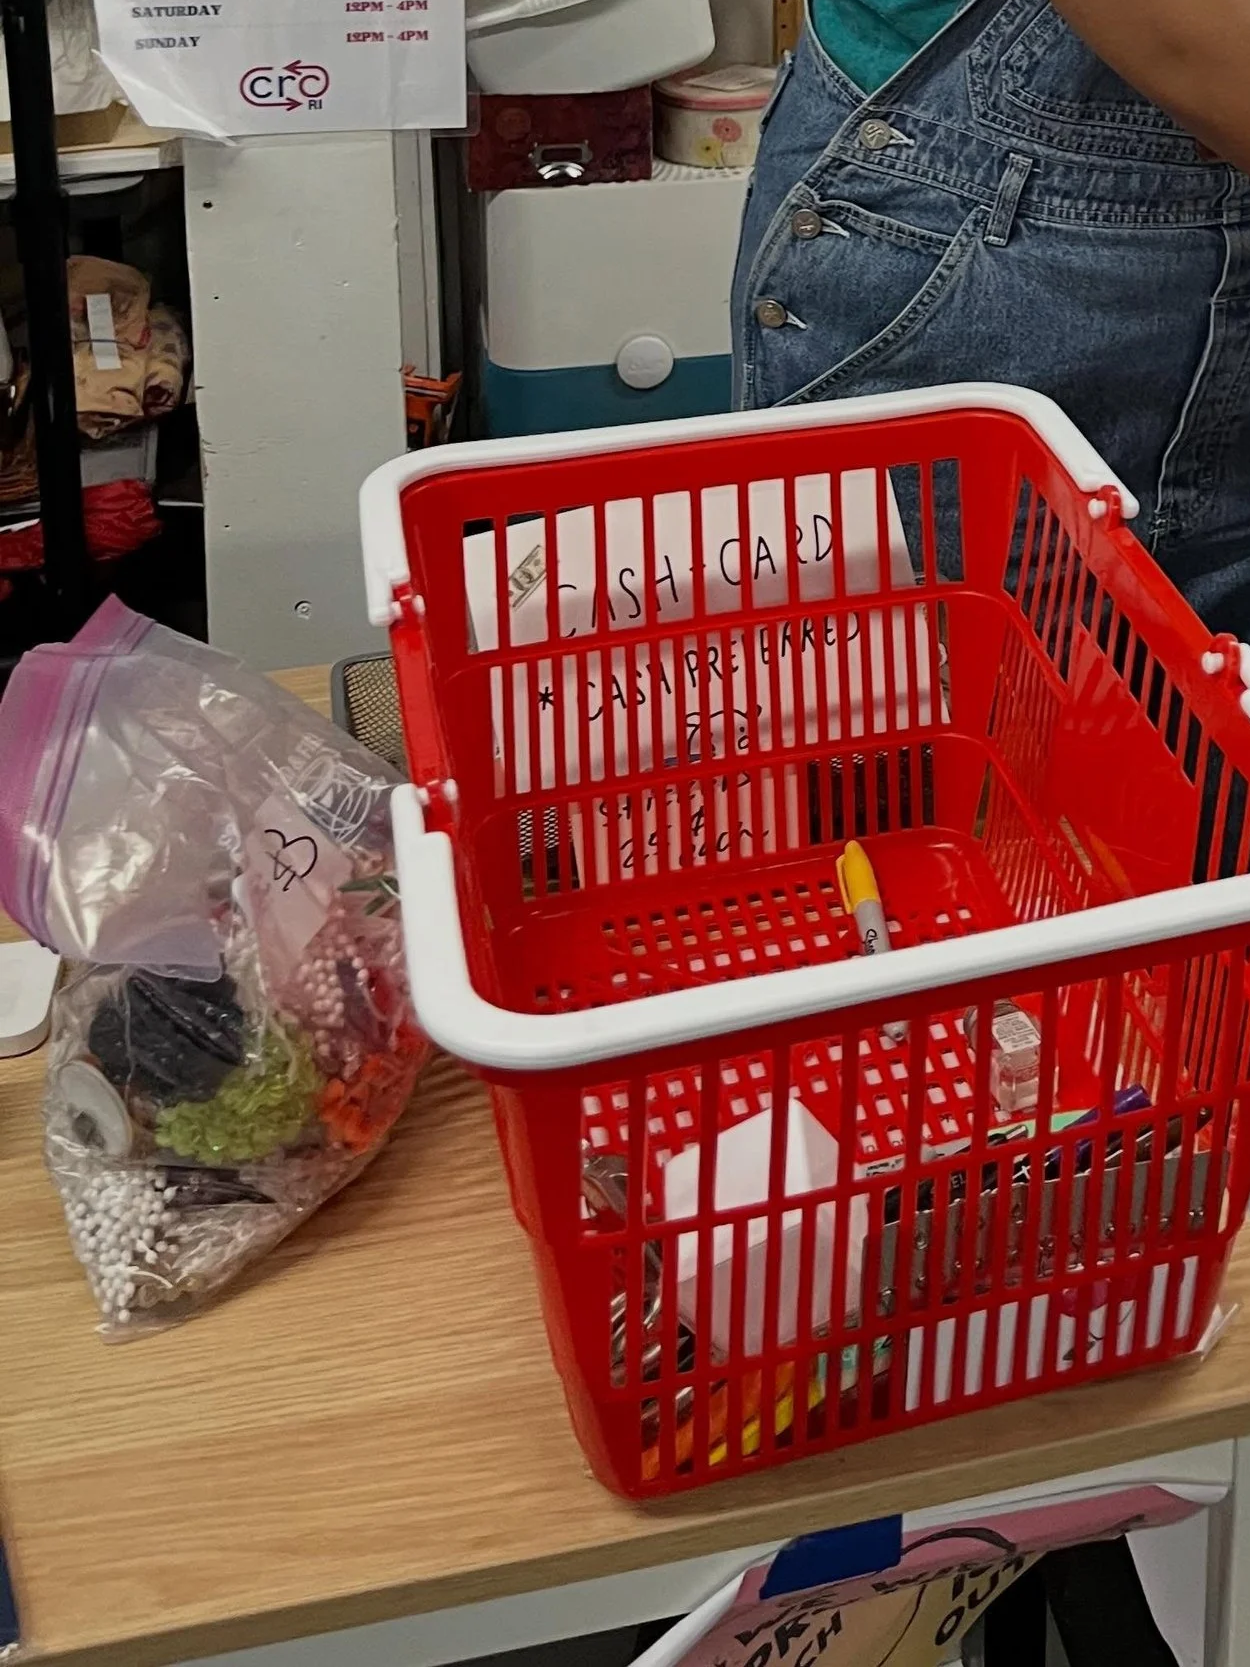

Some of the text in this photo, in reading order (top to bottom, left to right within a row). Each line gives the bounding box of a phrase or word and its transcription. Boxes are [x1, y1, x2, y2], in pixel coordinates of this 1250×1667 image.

[131, 4, 222, 19] SATURDAY
[396, 0, 428, 12] 4PM
[135, 36, 201, 51] SUNDAY
[308, 99, 323, 111] RI
